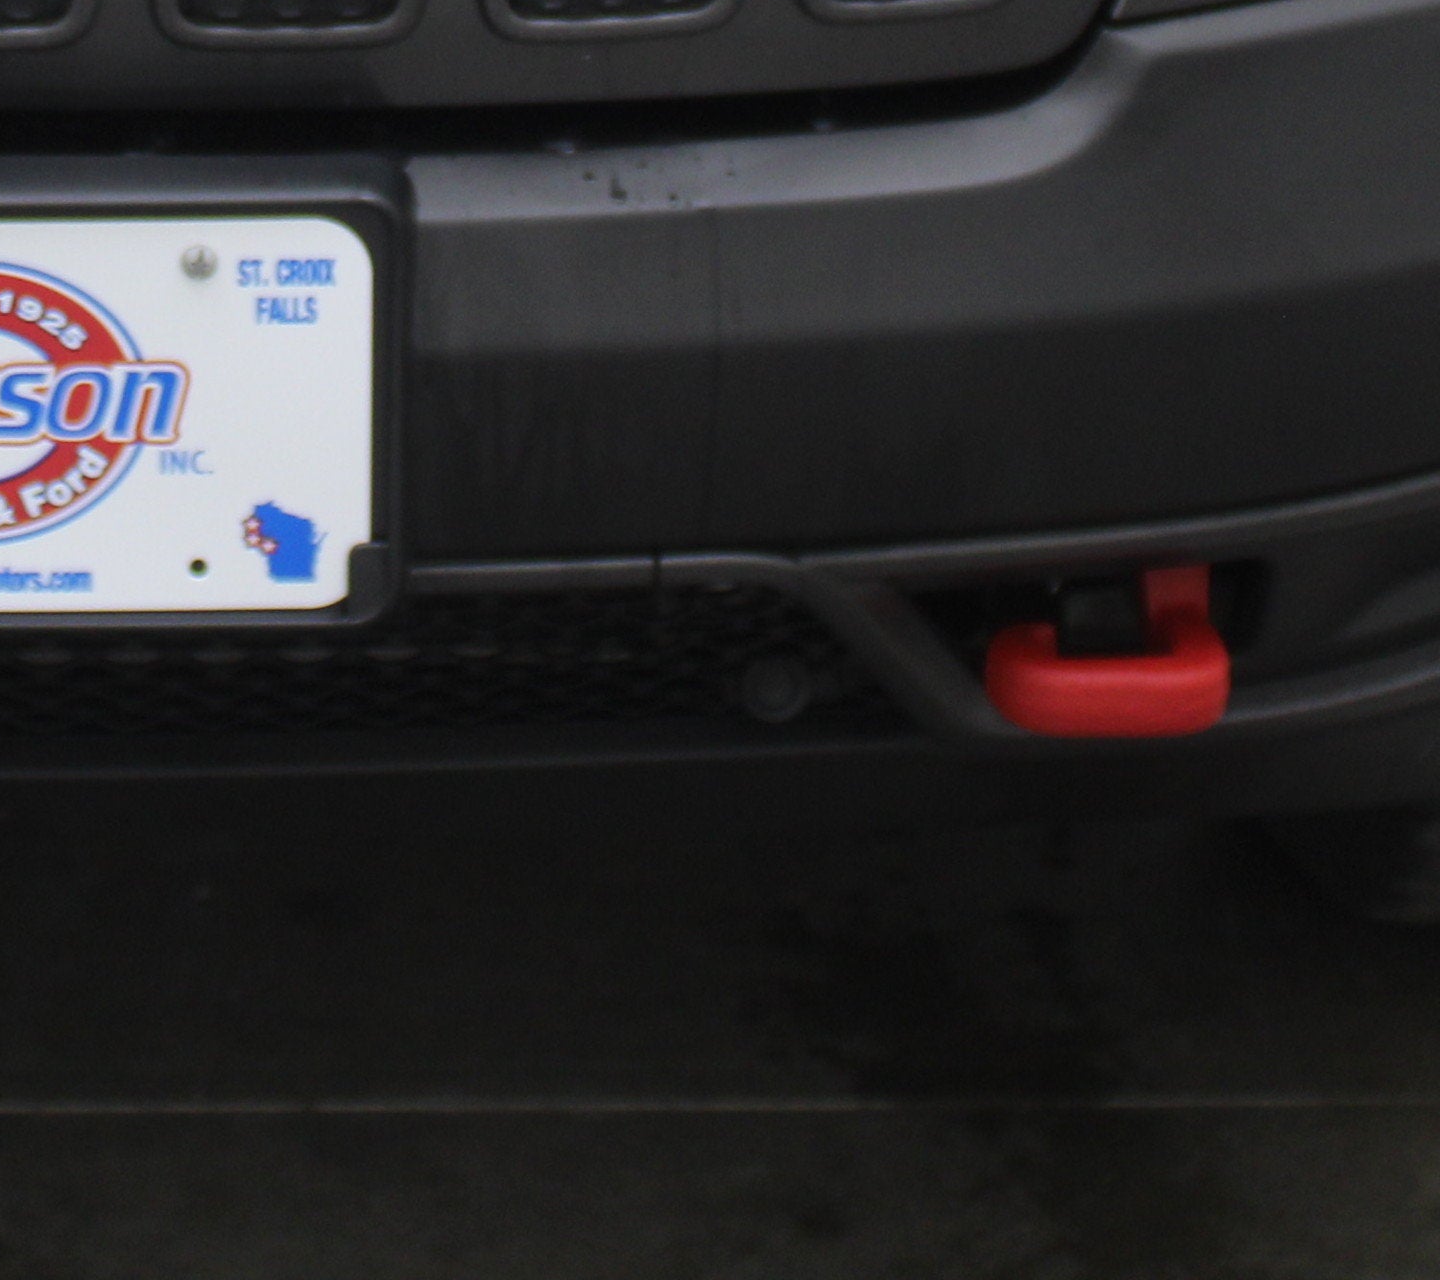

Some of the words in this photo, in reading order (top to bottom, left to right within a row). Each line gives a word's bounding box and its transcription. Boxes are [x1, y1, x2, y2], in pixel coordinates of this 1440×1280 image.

[237, 259, 268, 287] ST.
[276, 259, 337, 287] CROIX
[255, 297, 319, 325] FALLS
[159, 450, 214, 476] INC.
[20, 446, 109, 518] Ford
